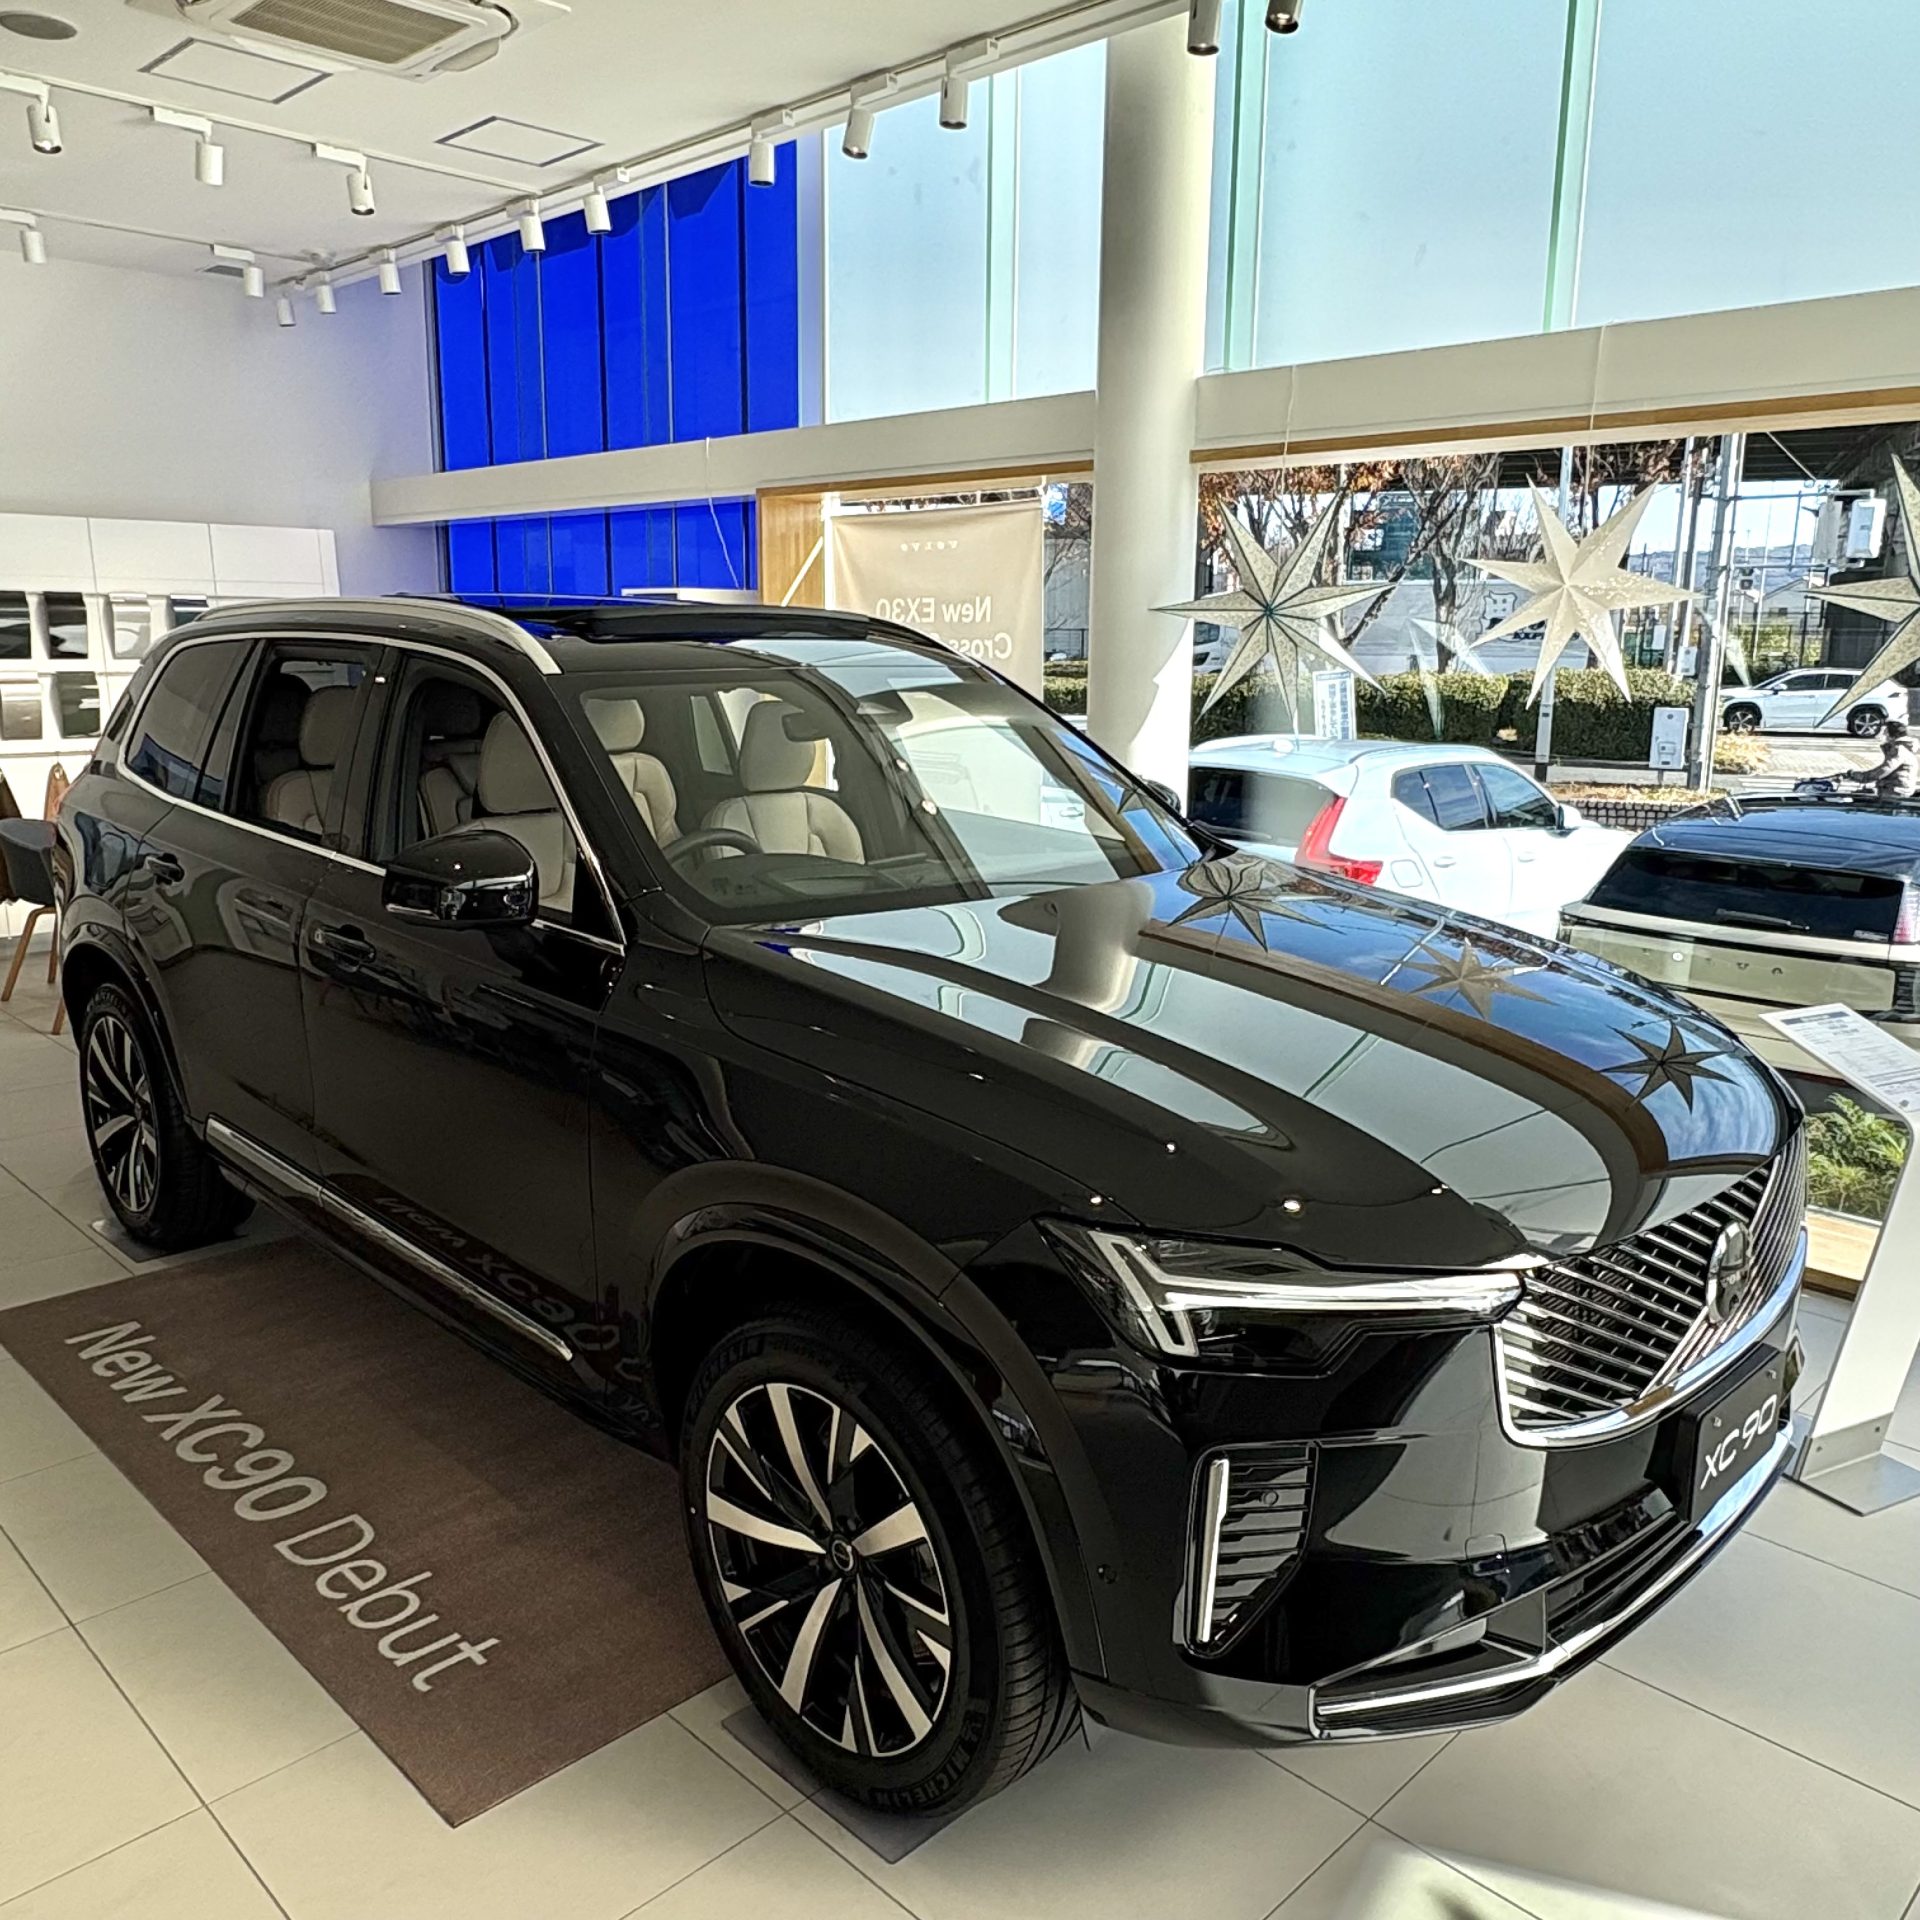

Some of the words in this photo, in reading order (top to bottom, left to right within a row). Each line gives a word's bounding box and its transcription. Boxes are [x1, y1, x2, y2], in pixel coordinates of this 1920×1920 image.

[64, 1320, 188, 1403] New
[142, 1394, 328, 1522] XC90
[273, 1513, 501, 1692] Debut
